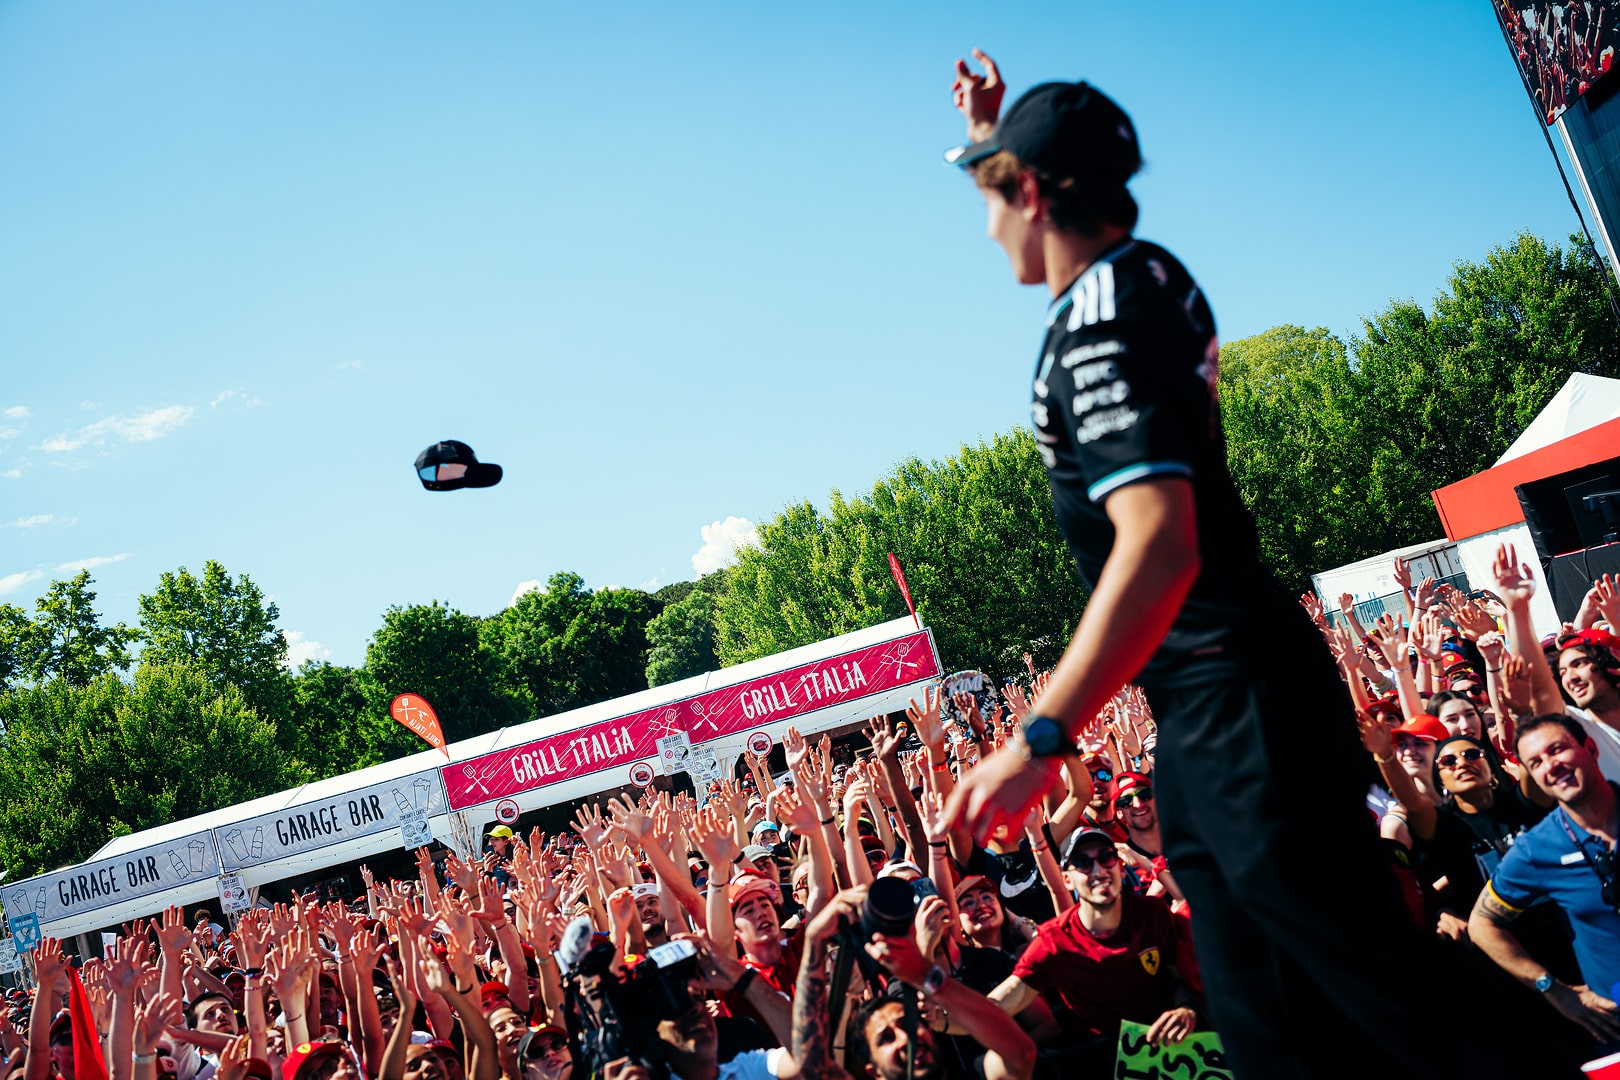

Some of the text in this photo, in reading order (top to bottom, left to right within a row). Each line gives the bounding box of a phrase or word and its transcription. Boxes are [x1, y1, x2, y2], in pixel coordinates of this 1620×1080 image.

[946, 673, 983, 698] KIMI
[897, 749, 920, 757] PETRO
[275, 794, 385, 846] GARAGE BAR
[58, 855, 160, 907] GARAGE BAR
